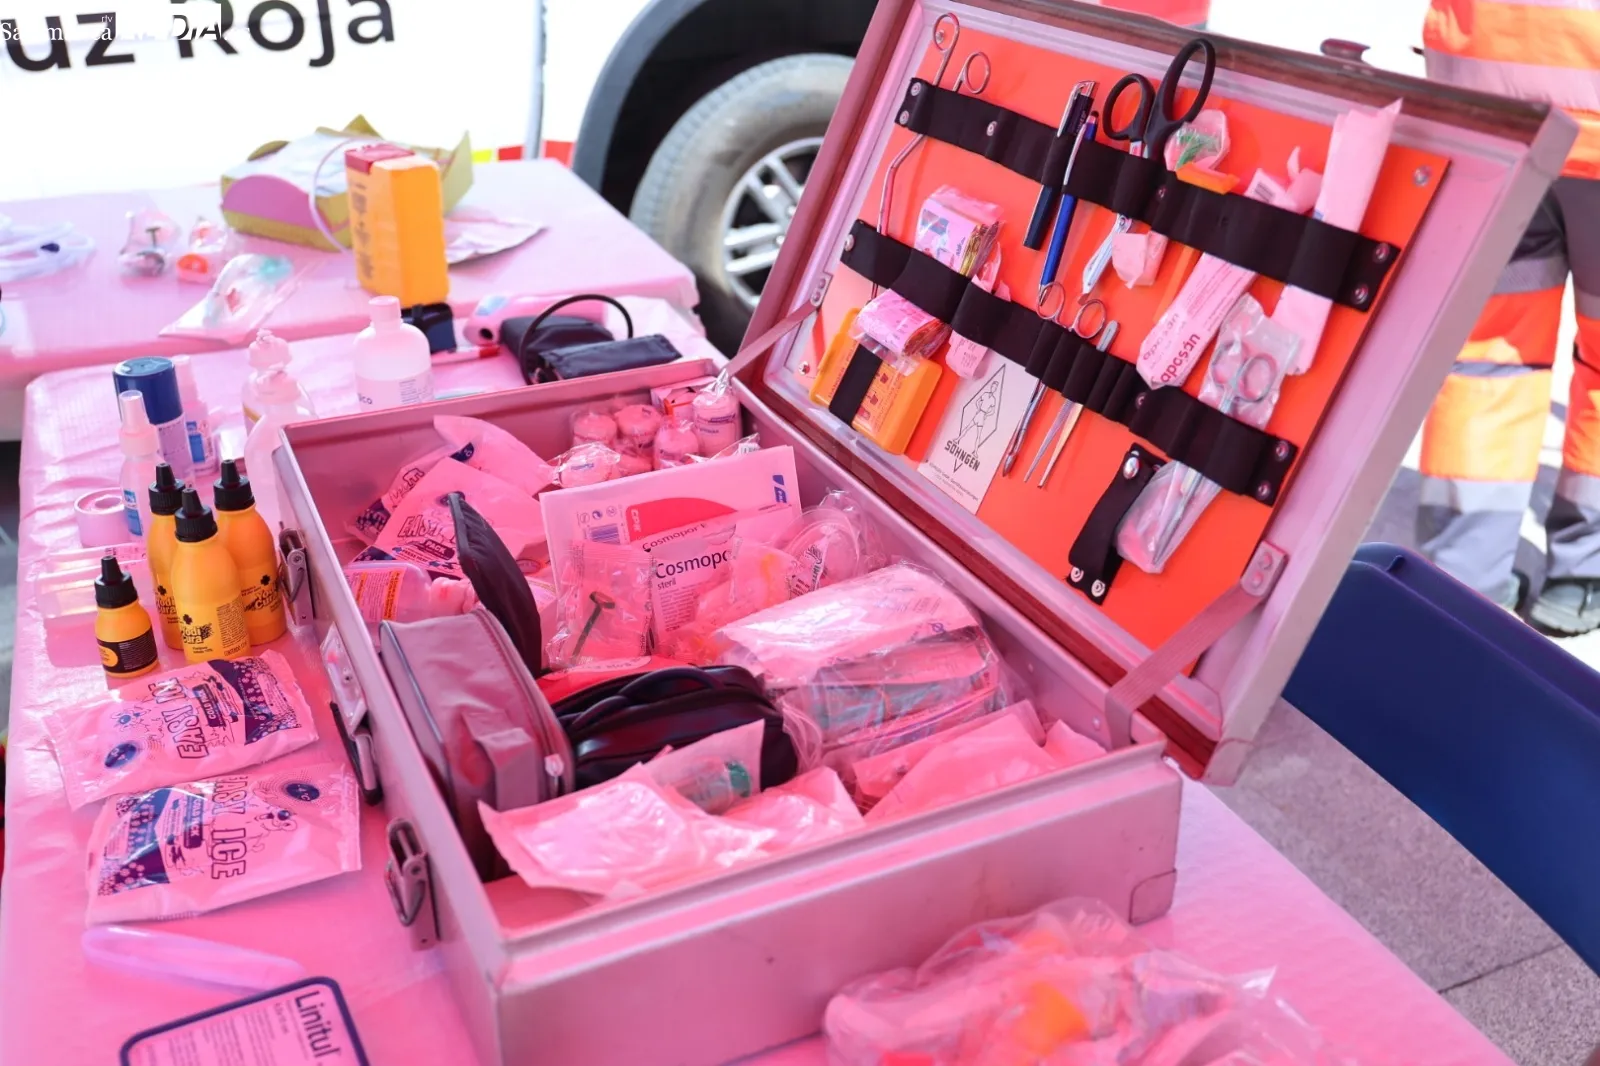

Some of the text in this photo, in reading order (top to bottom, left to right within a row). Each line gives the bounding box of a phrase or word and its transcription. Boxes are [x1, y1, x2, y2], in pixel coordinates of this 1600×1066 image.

[170, 0, 395, 67] Roja
[424, 539, 447, 555] PACK
[642, 523, 702, 553] Cosmopor
[657, 576, 677, 591] steril
[162, 704, 210, 760] EASY
[210, 828, 248, 880] ICE
[294, 990, 343, 1060] Linitul
